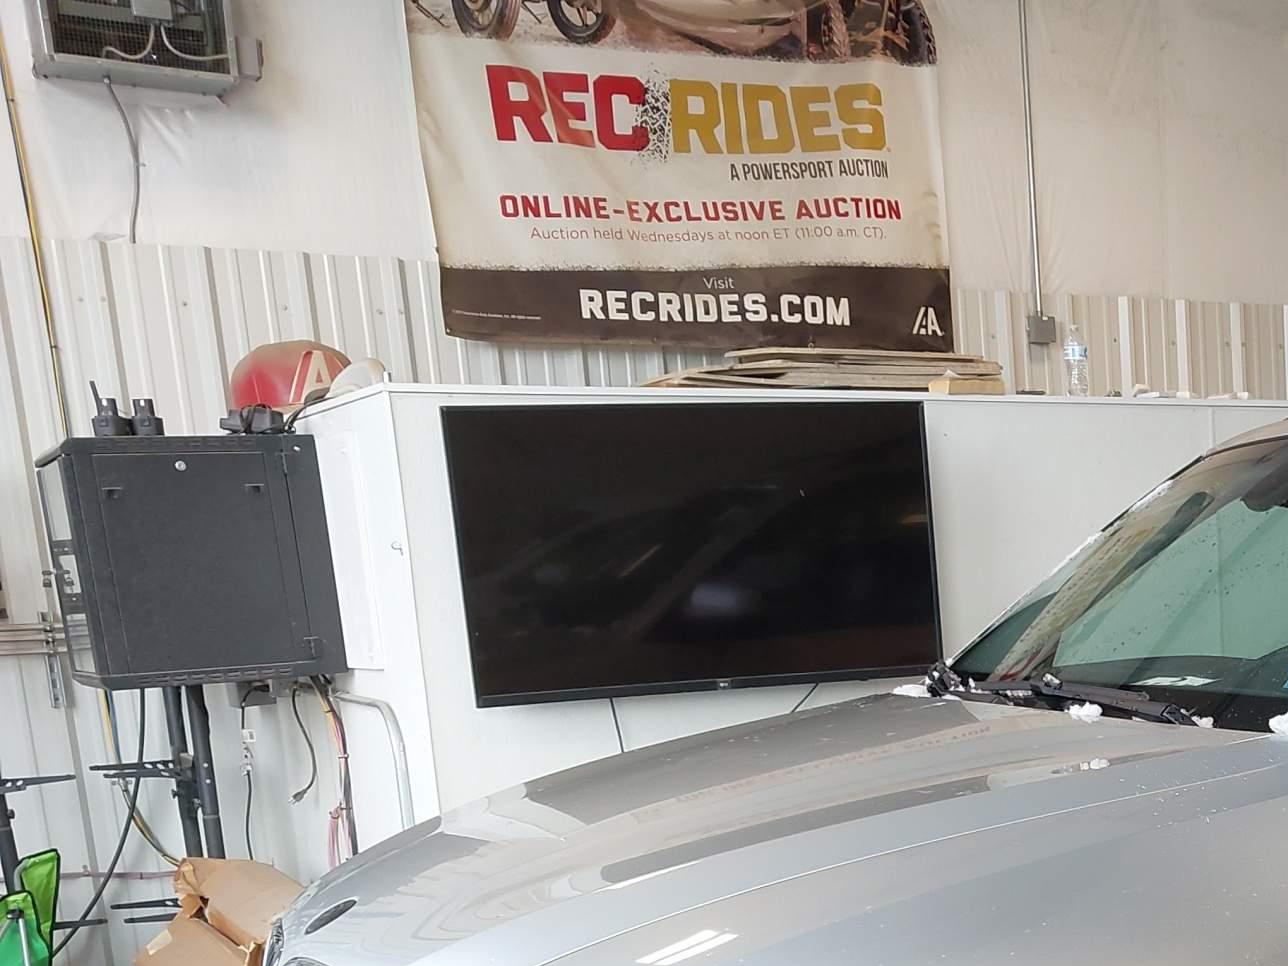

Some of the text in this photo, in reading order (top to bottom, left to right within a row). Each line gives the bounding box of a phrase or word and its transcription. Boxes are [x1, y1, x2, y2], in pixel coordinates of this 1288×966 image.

[485, 64, 887, 155] REC RIDES
[730, 158, 888, 181] A POWERSPORT AUCTION
[500, 194, 902, 223] ONLINE-EXCLUSIVE AUCTION
[530, 227, 589, 241] Auction
[593, 227, 623, 241] held
[627, 228, 714, 243] Wednesdays
[718, 230, 731, 241] at
[735, 230, 769, 241] noon
[773, 228, 790, 240] ET
[795, 225, 833, 241] (11:00
[863, 226, 887, 240] CT).
[703, 277, 735, 290] Visit
[579, 288, 851, 327] RECRIDES.COM
